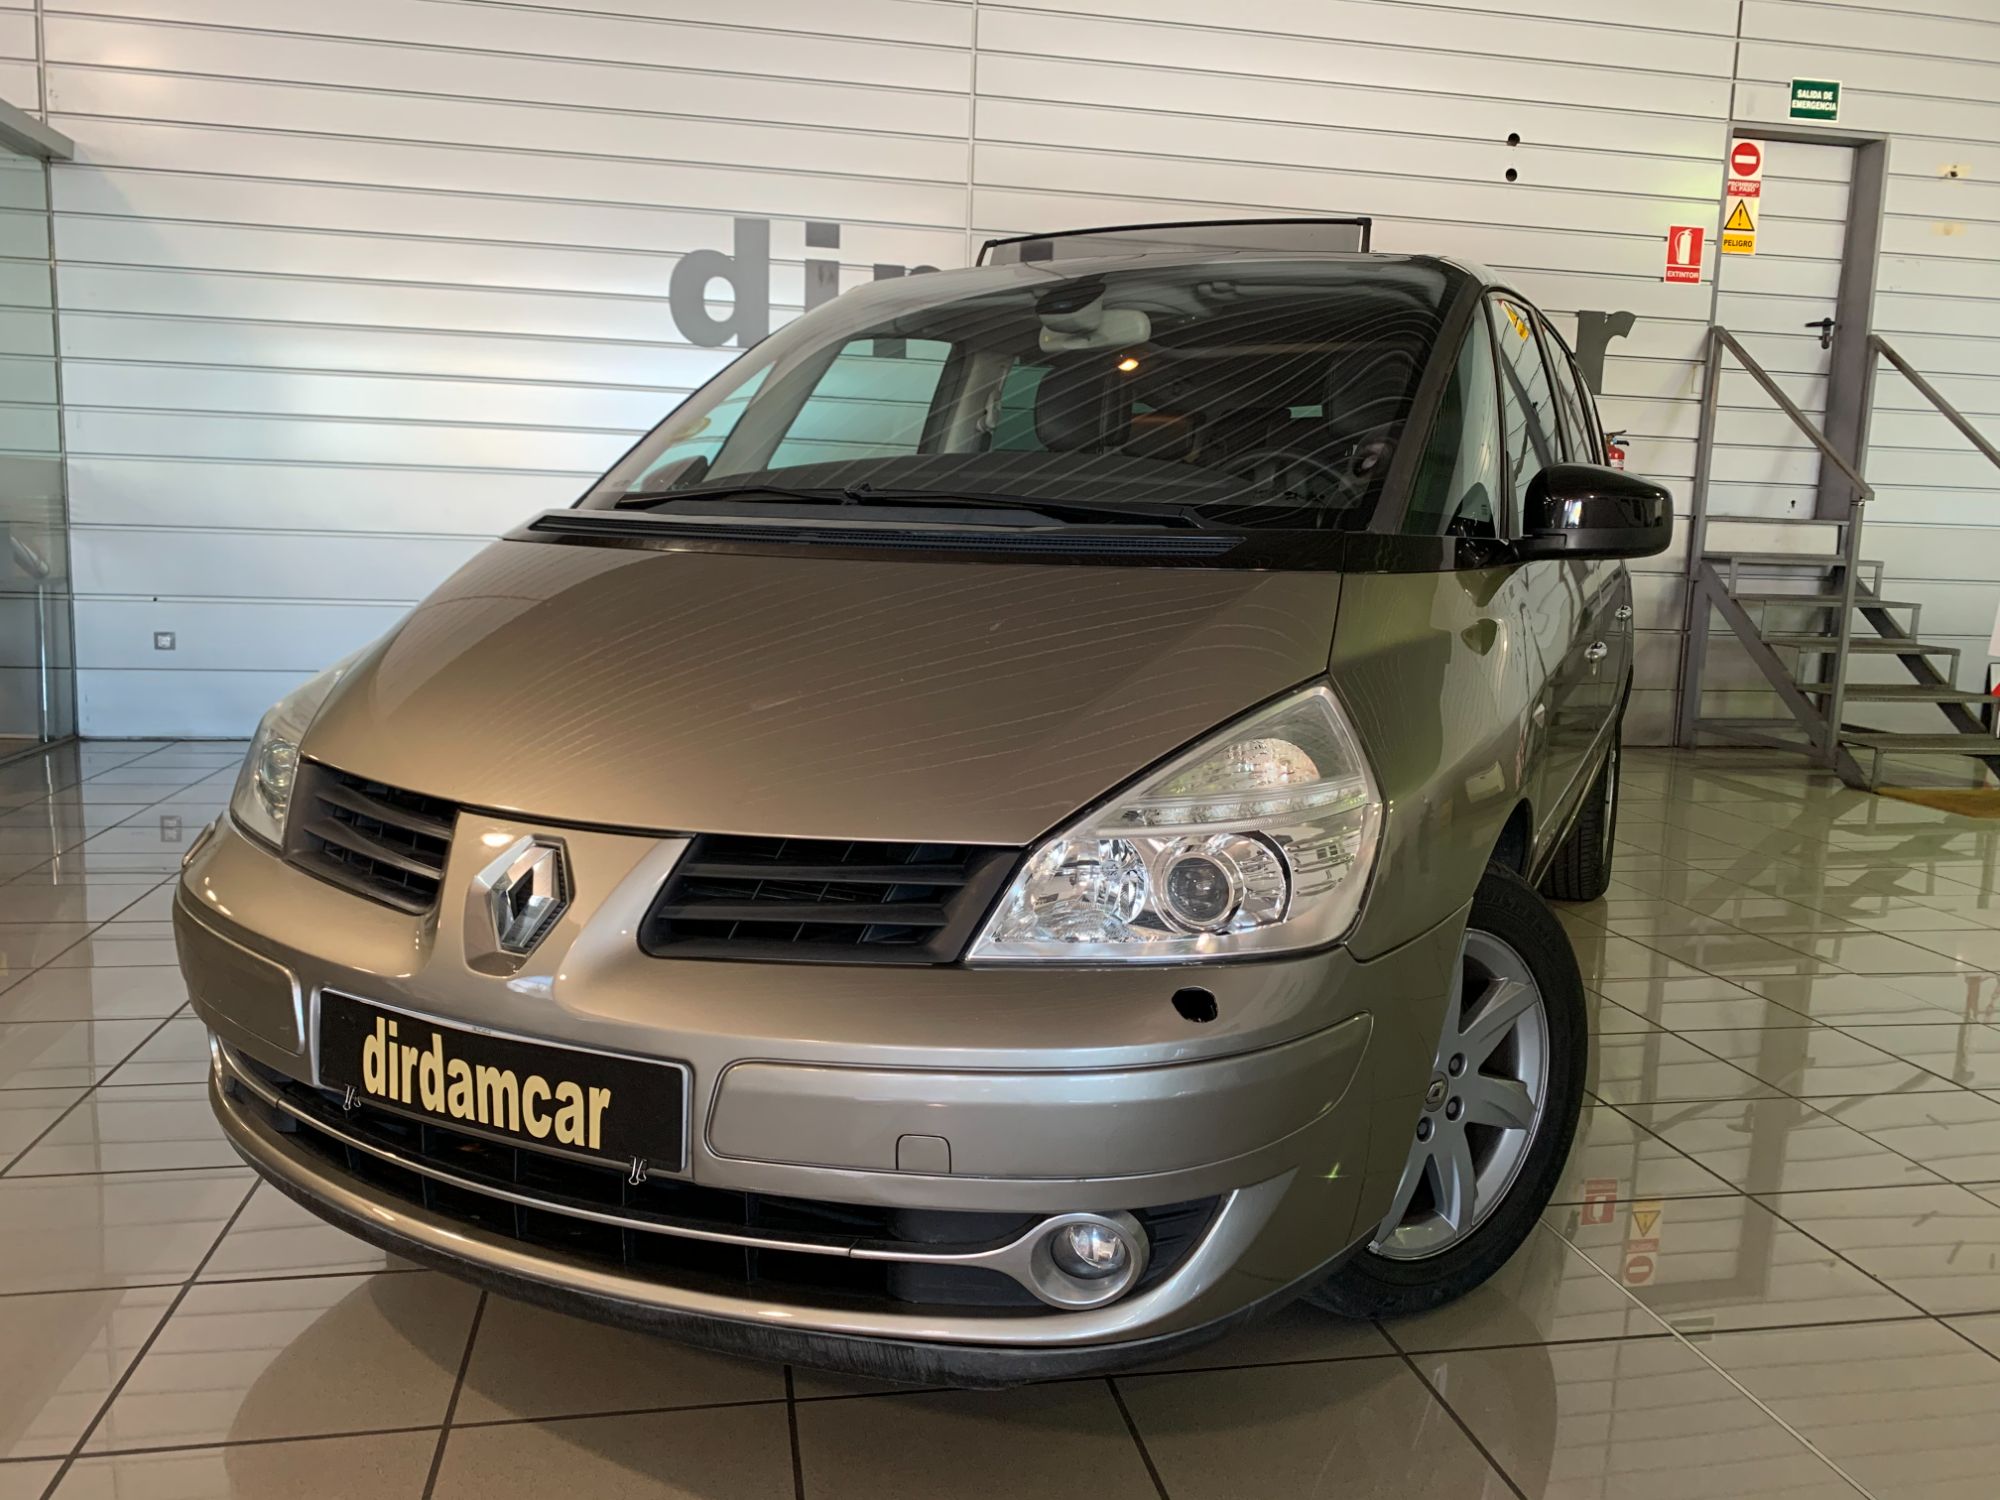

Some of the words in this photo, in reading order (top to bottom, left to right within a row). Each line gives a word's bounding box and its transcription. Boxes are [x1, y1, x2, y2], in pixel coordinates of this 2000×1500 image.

[1797, 89, 1822, 99] SALIDA
[1823, 91, 1834, 100] DE
[1791, 99, 1837, 111] EMERGENCIA
[1723, 239, 1753, 248] PELIGRO
[1667, 270, 1699, 279] EXTINTOR
[363, 1016, 611, 1149] dirdamcar
